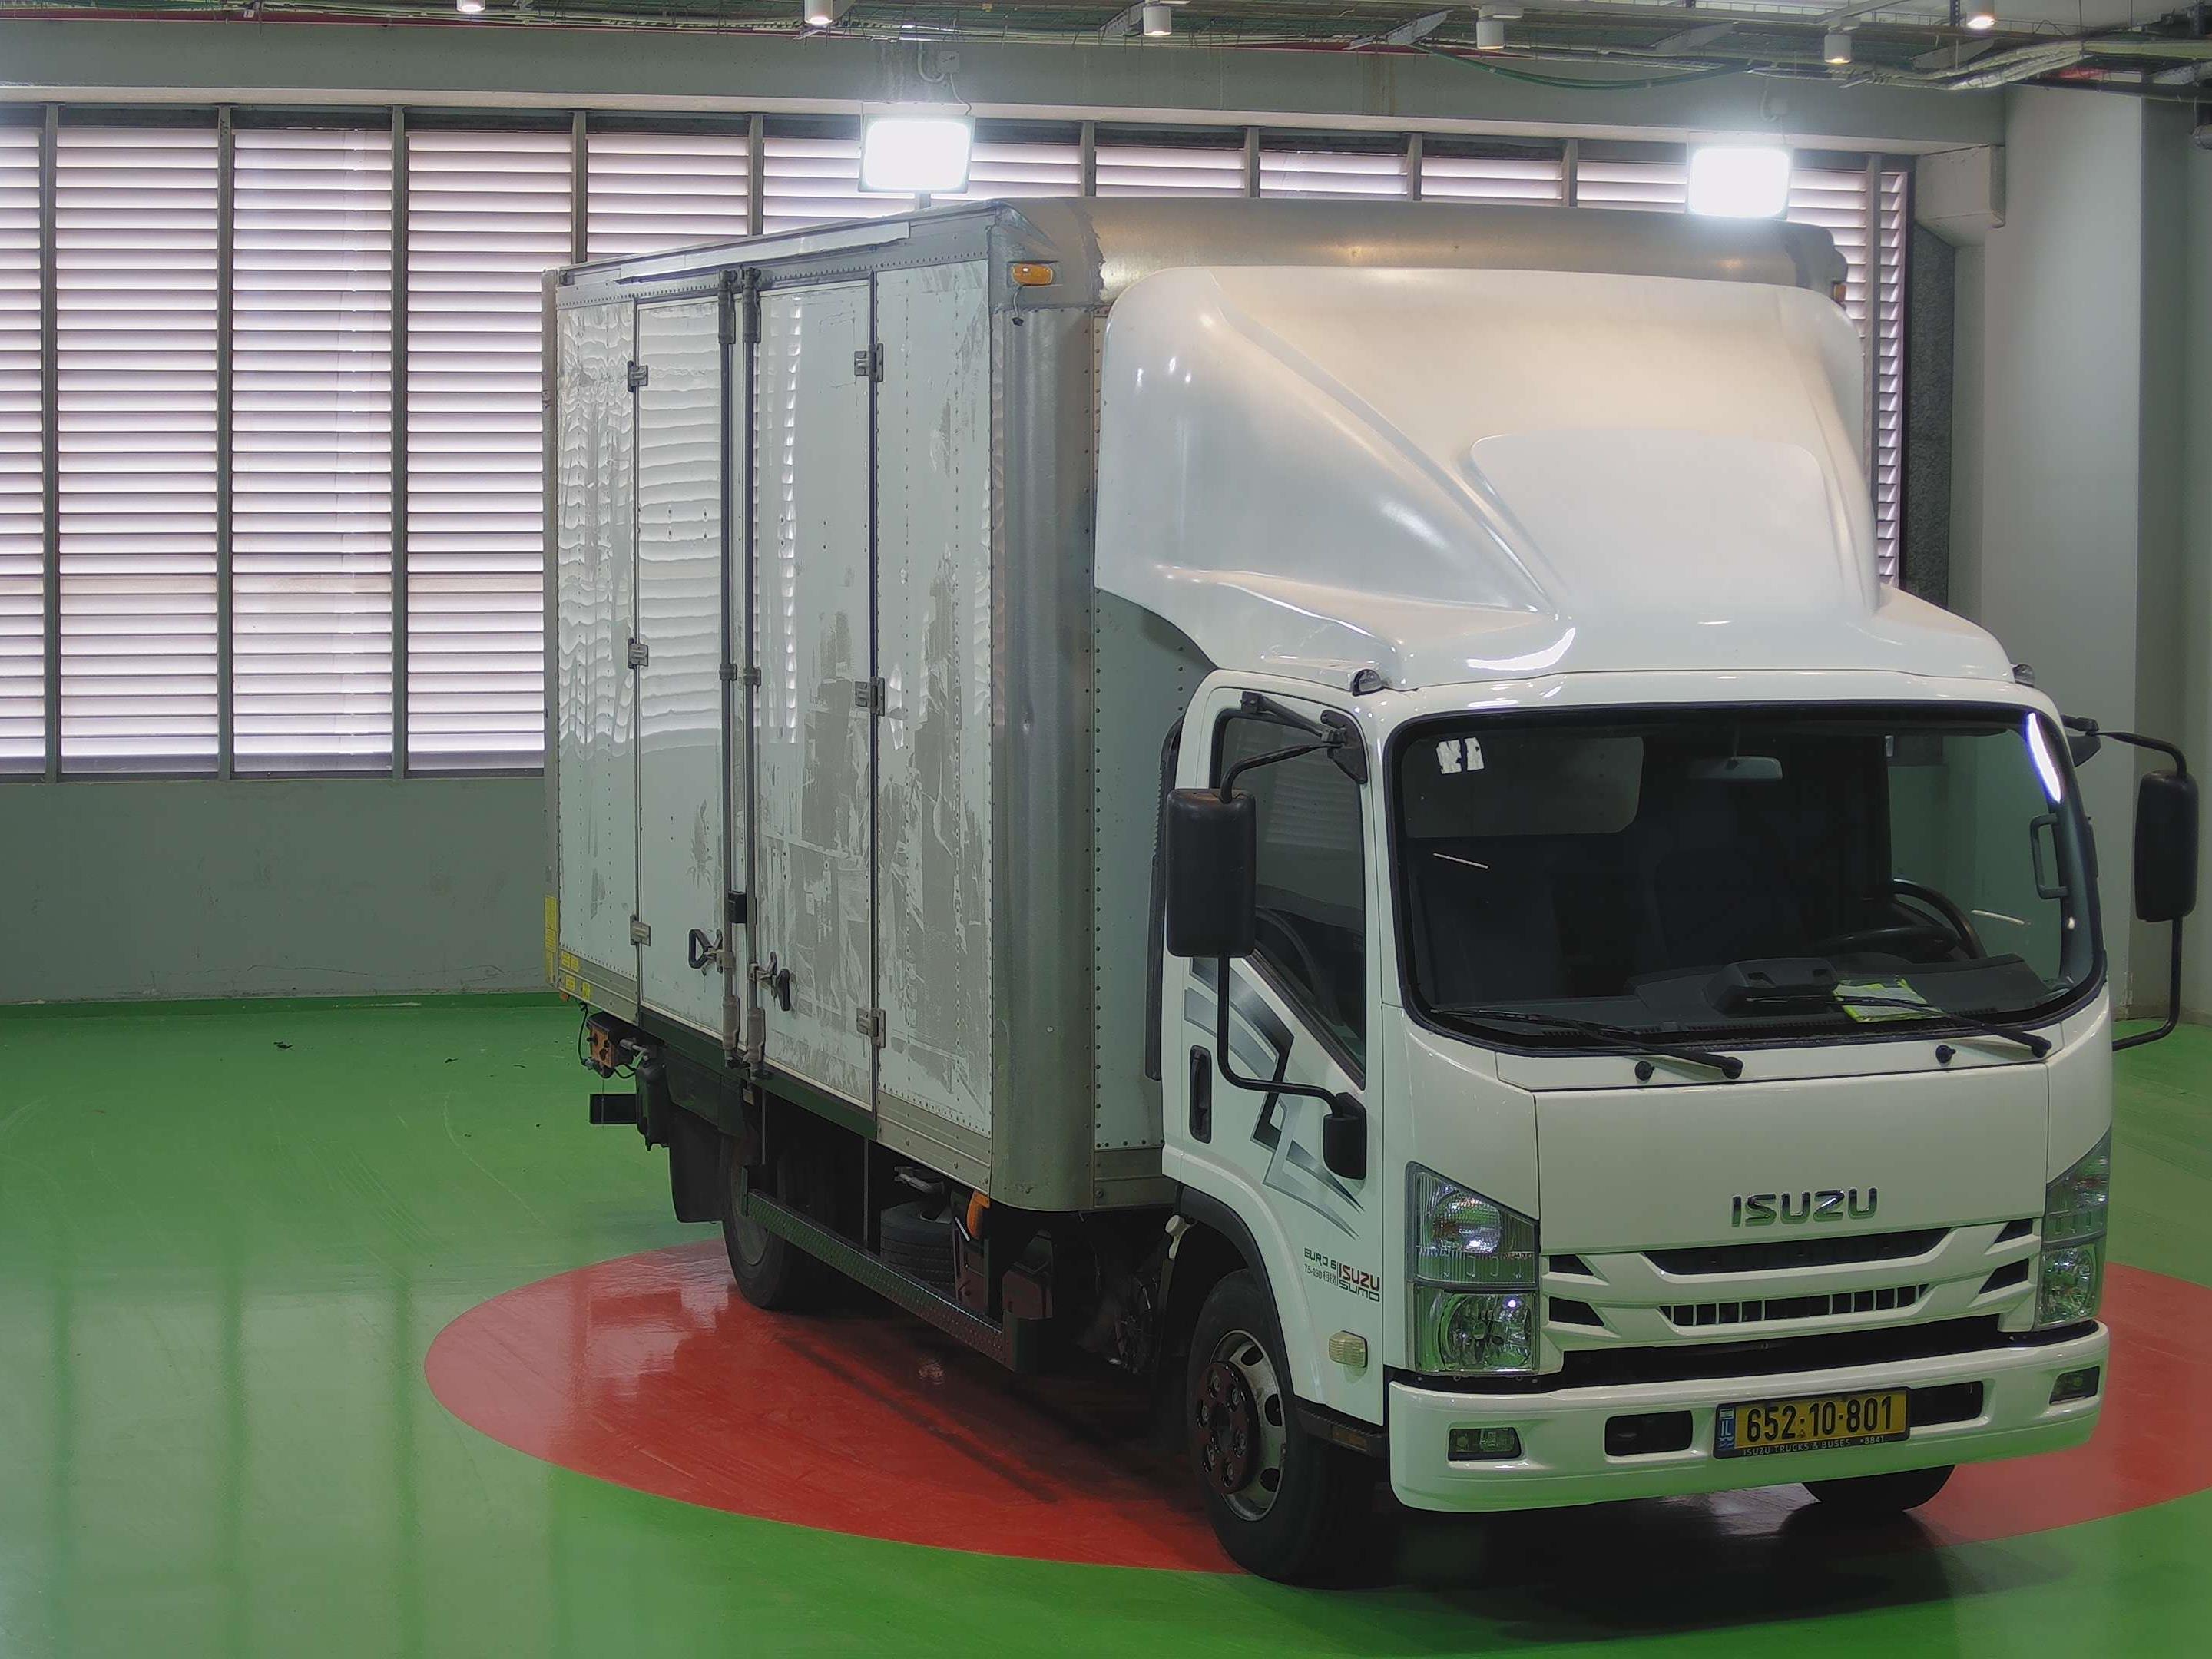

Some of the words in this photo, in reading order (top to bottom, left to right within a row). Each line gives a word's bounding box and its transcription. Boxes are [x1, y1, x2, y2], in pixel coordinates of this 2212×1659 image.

[1731, 1187, 1878, 1227] ISUZU
[1303, 1247, 1329, 1267] EURO
[1330, 1259, 1337, 1270] 6
[1339, 1263, 1380, 1292] ISUZU
[1339, 1279, 1380, 1303] SUMO
[1720, 1419, 1732, 1437] IL
[1742, 1447, 1771, 1457] ISUZU
[1775, 1443, 1810, 1453] TRUCKS
[1821, 1439, 1851, 1449] BUSES
